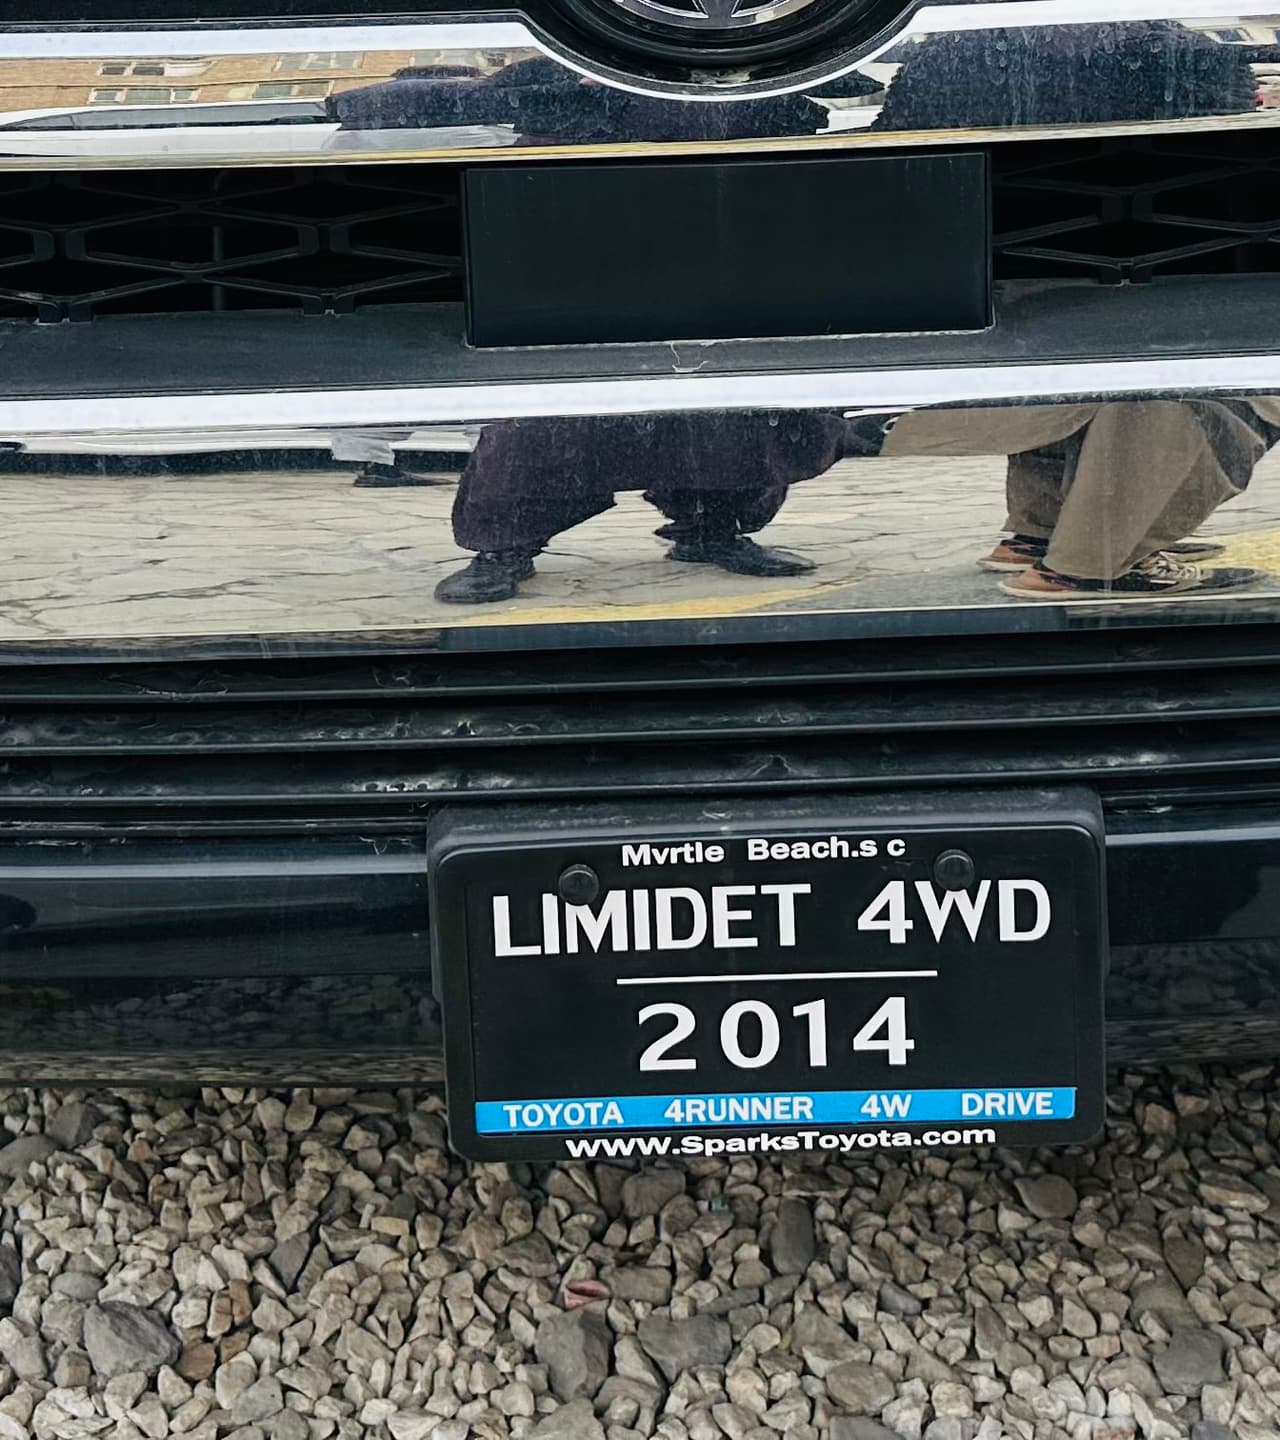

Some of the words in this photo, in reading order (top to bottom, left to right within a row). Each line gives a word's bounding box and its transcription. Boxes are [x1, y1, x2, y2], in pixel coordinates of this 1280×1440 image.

[493, 883, 812, 957] LIMIDET
[857, 879, 1052, 944] 4WD
[638, 996, 915, 1072] 2014
[503, 1101, 625, 1128] TOYOTA
[663, 1096, 814, 1123] 4RUNNER
[860, 1093, 913, 1118] 4W
[961, 1091, 1054, 1117] DRIVE
